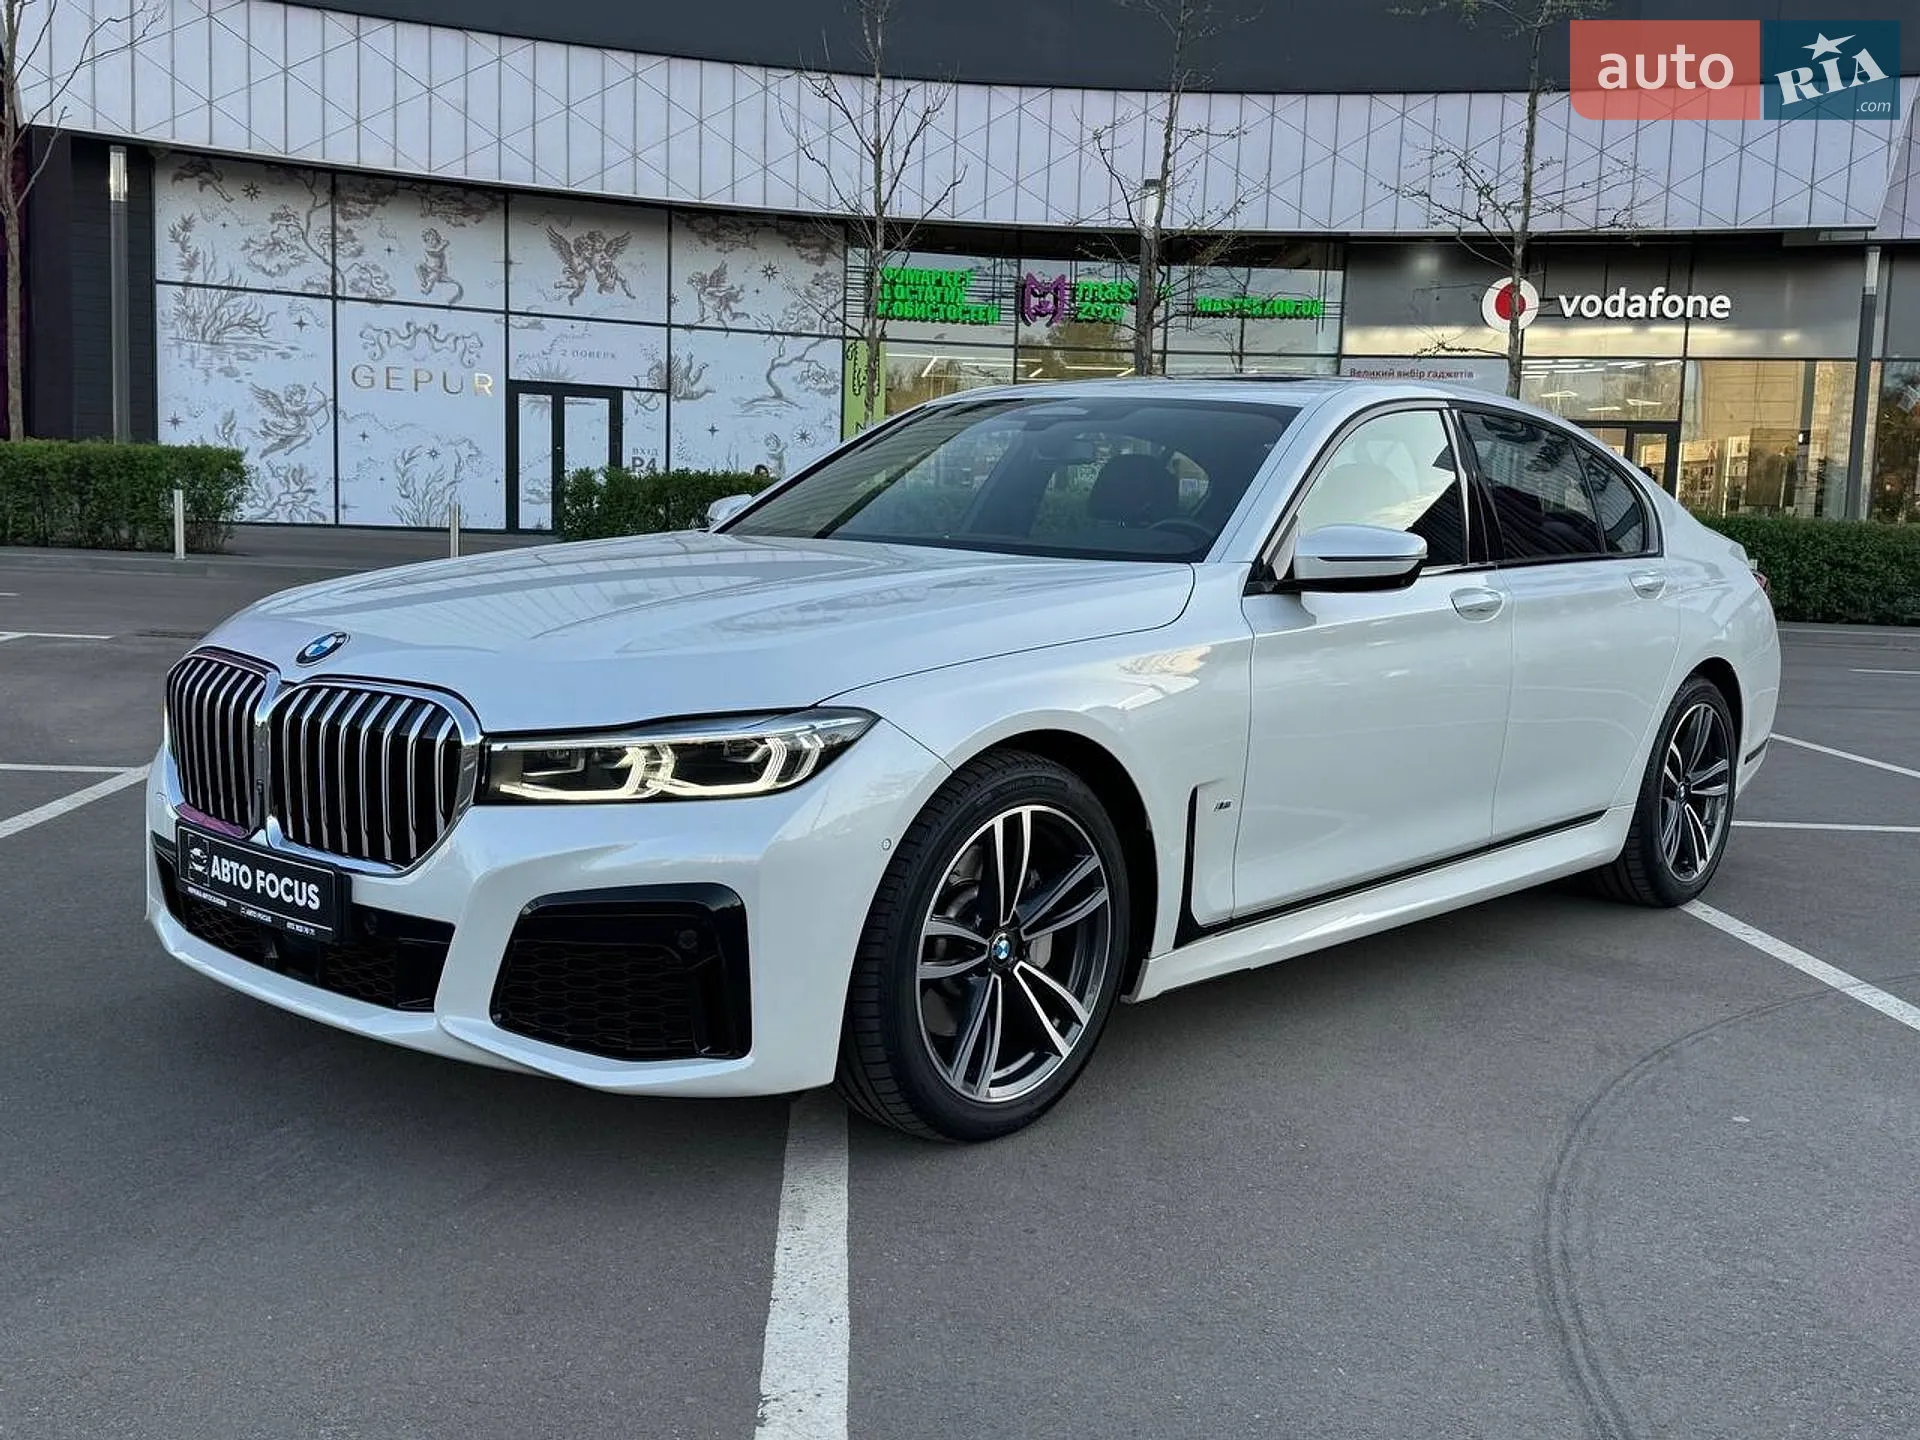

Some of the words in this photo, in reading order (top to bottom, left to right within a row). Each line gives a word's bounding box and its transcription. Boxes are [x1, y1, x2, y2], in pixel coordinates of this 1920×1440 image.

[882, 266, 976, 287] ООМАРКЕТ
[1559, 287, 1731, 318] vodafone
[351, 363, 494, 398] GEPUR
[210, 855, 252, 891] АВТО
[256, 869, 321, 911] FOCUS
